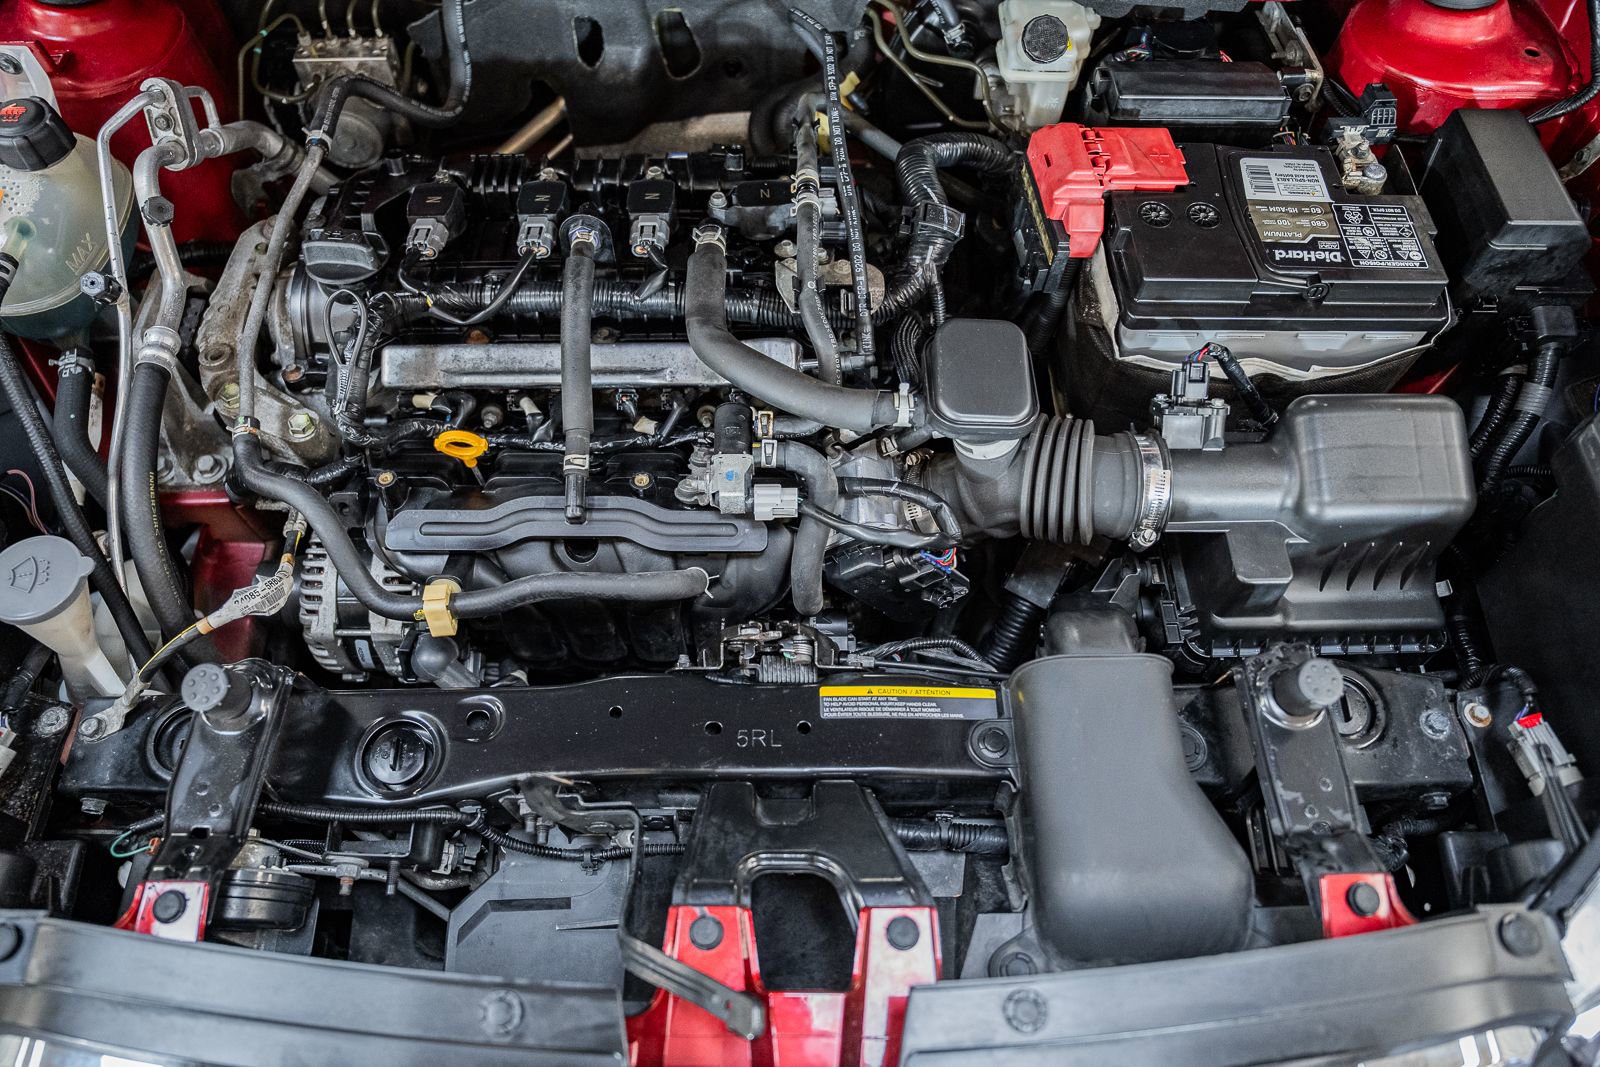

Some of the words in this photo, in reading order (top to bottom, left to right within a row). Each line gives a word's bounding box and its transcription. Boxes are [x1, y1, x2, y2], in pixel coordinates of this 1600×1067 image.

[826, 46, 834, 54] NOT
[832, 124, 840, 136] NOT
[834, 136, 842, 146] DO
[760, 189, 770, 198] N
[65, 232, 94, 273] MAX
[852, 242, 861, 252] DO
[854, 254, 864, 272] 9202
[858, 303, 868, 316] DTR
[736, 729, 782, 747] 5RL
